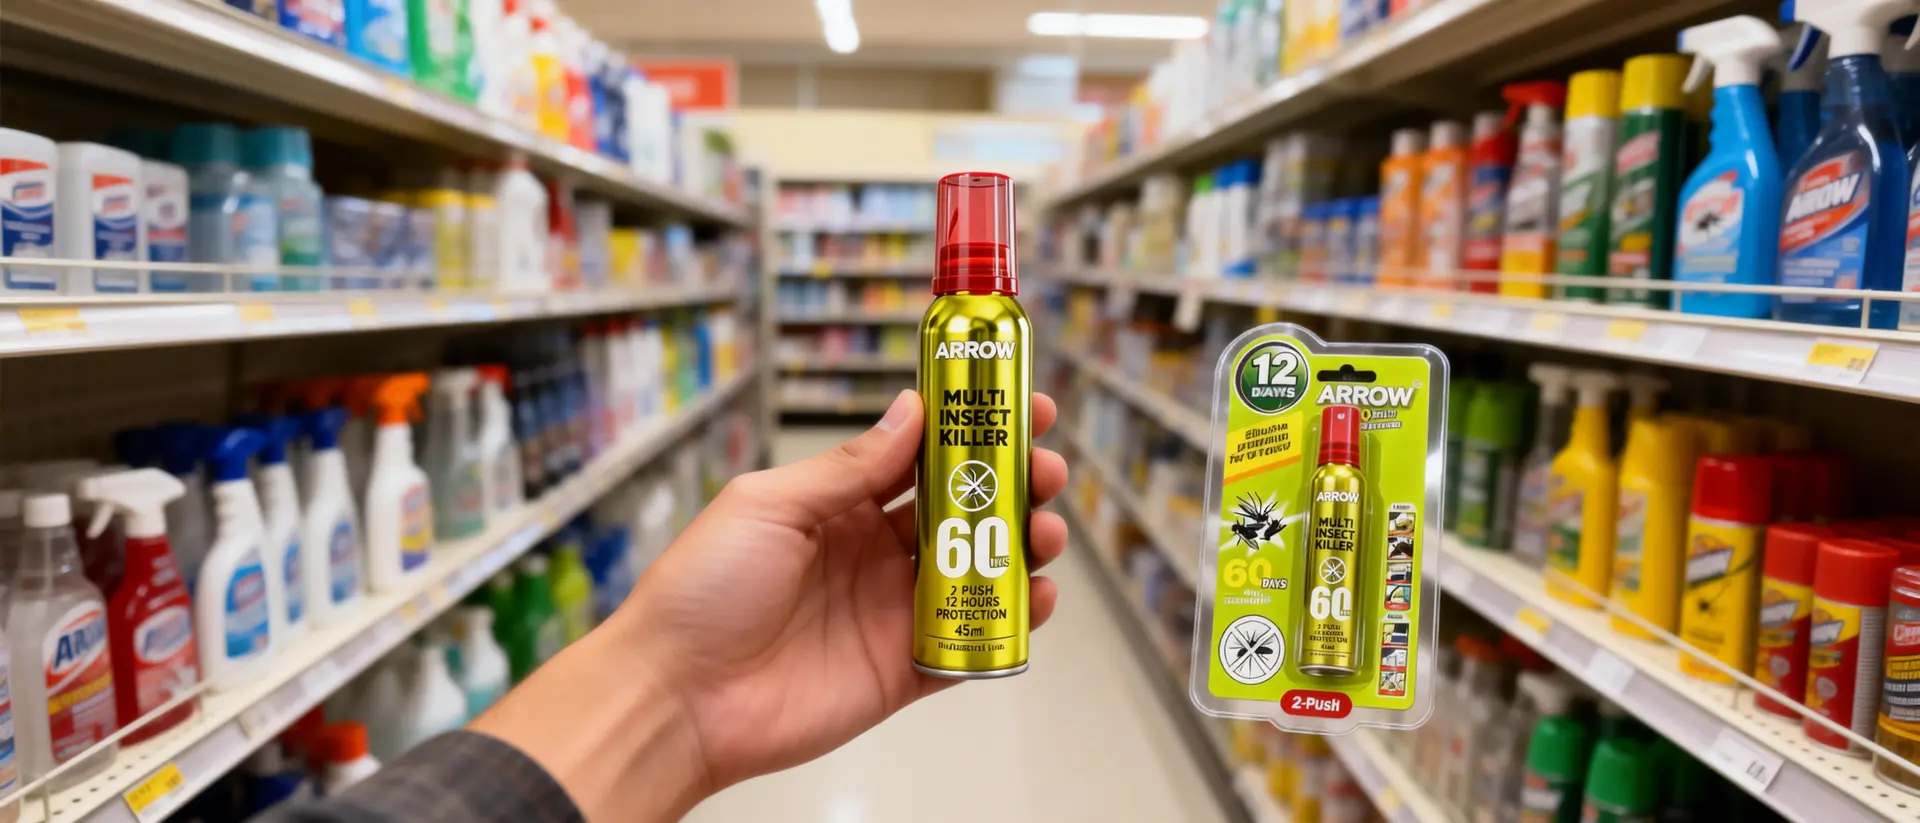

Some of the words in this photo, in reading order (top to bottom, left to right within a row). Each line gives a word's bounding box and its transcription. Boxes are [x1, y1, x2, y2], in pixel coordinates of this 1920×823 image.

[935, 341, 1016, 360] ARROW
[1252, 352, 1299, 386] 12
[943, 389, 1005, 407] MULTI
[1316, 384, 1415, 407] ARROW
[940, 409, 1011, 426] INSECT
[940, 429, 1008, 446] KILLER
[1316, 491, 1360, 504] ARROW
[1318, 517, 1354, 529] MULTI
[1315, 528, 1355, 540] INSECT
[936, 516, 1010, 579] 60
[1315, 539, 1354, 552] KILLER
[1223, 557, 1272, 589] 60
[950, 585, 957, 596] 2
[961, 585, 994, 596] PUSH
[945, 597, 957, 607] 12
[961, 596, 1000, 607] HOURS
[1309, 585, 1352, 622] 60
[936, 608, 1007, 620] PROTECTION
